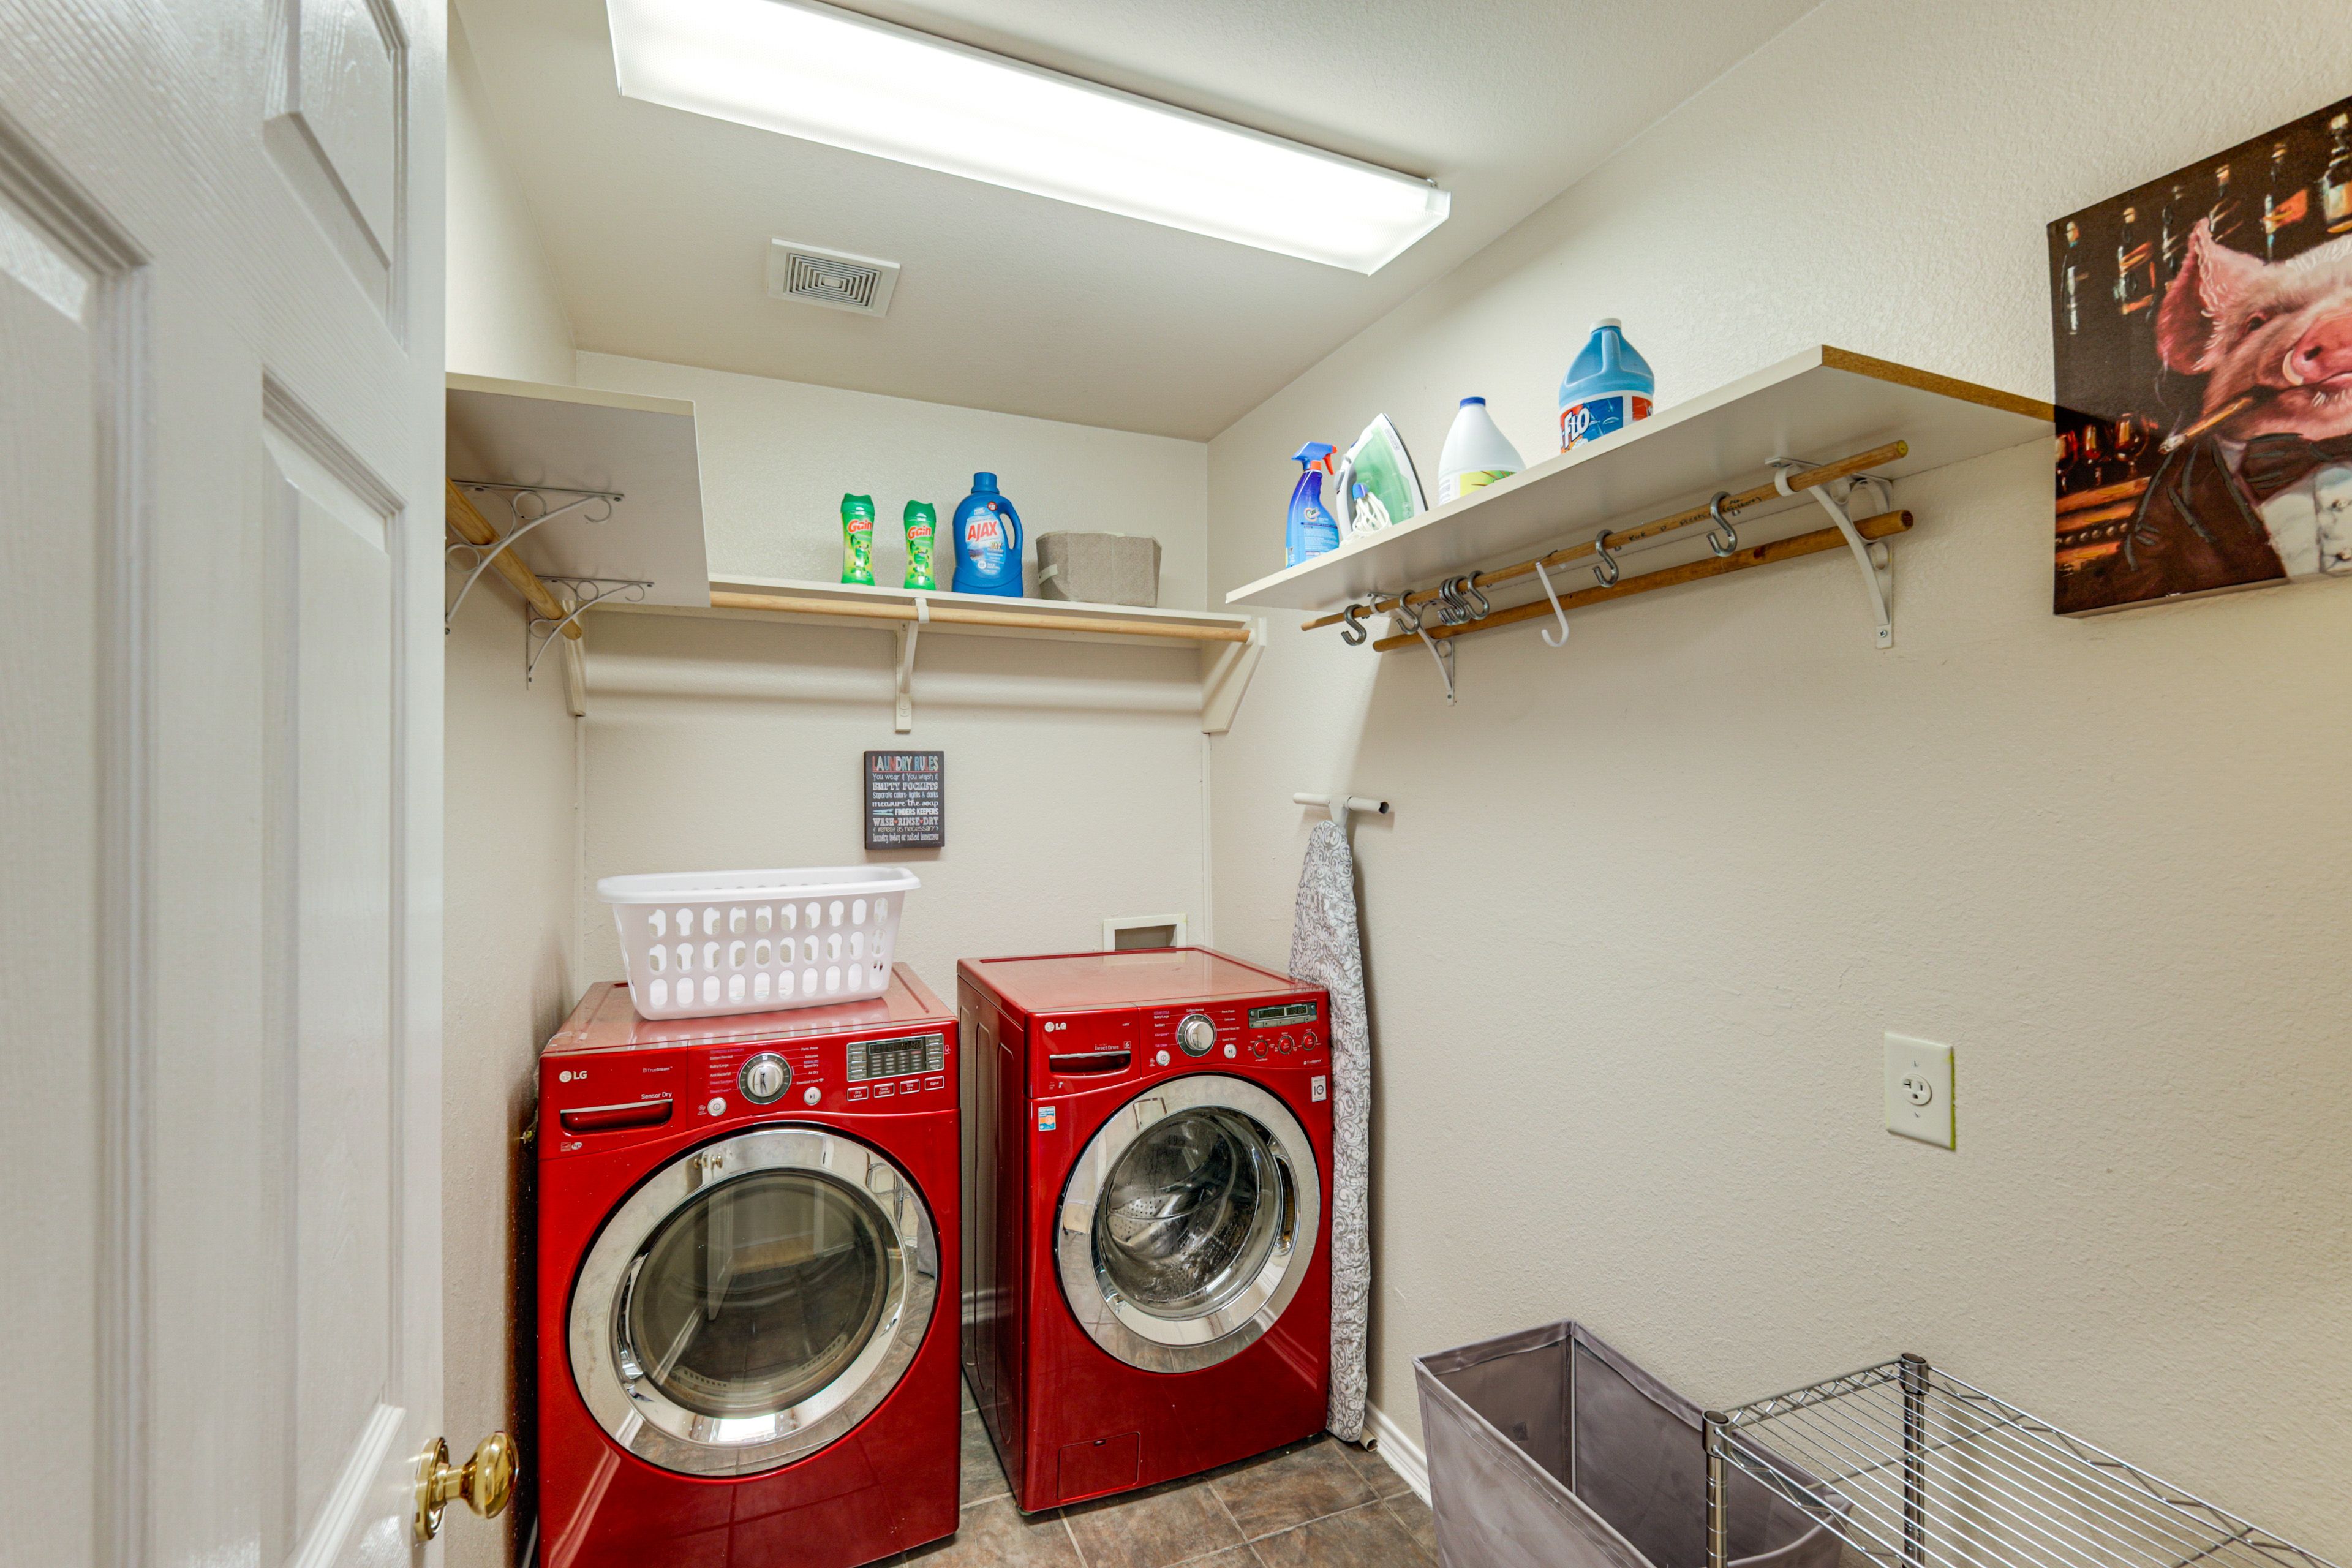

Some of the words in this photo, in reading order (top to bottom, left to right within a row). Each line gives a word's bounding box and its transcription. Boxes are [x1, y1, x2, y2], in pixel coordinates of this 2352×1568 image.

[1560, 407, 1591, 448] -FLO
[848, 519, 873, 533] Gain
[908, 526, 932, 540] Gain
[967, 521, 998, 541] AJAX
[872, 756, 913, 771] LAUNDRY
[914, 756, 938, 771] RULES
[873, 817, 894, 826] WASH
[897, 817, 919, 826] RINSE
[873, 833, 888, 843] laundry
[889, 833, 900, 843] today
[573, 1071, 587, 1080] LG
[1314, 1084, 1324, 1096] 10
